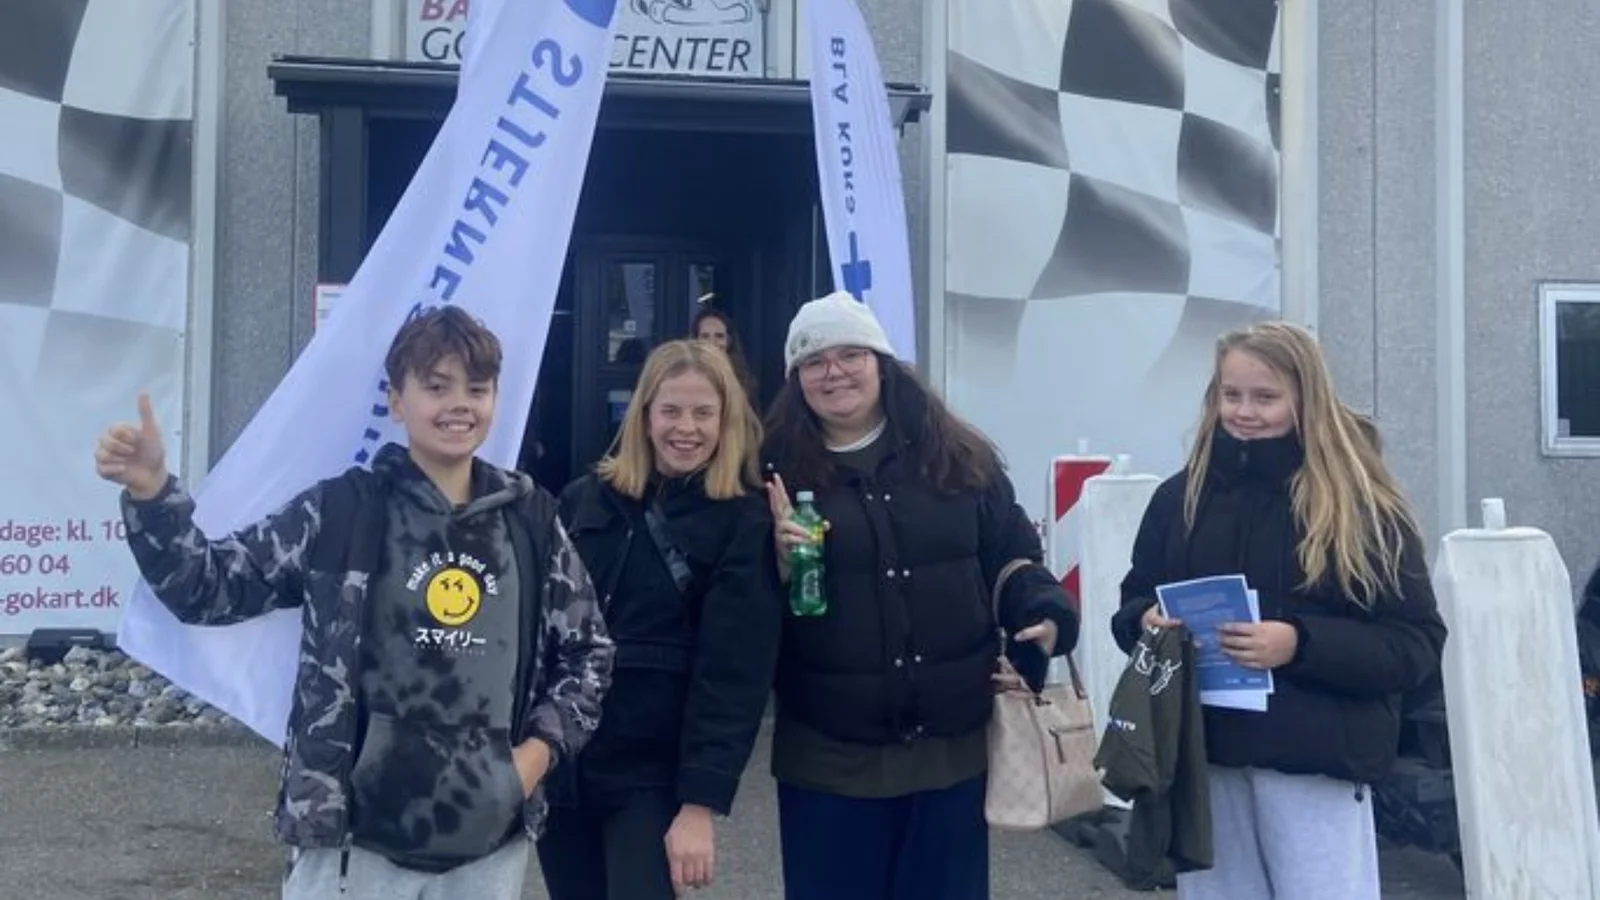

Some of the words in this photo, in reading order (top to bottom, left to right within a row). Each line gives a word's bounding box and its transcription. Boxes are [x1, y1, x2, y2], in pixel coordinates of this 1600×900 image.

[67, 519, 93, 541] kl.
[38, 554, 70, 574] 04
[415, 627, 487, 647] スマイリー
